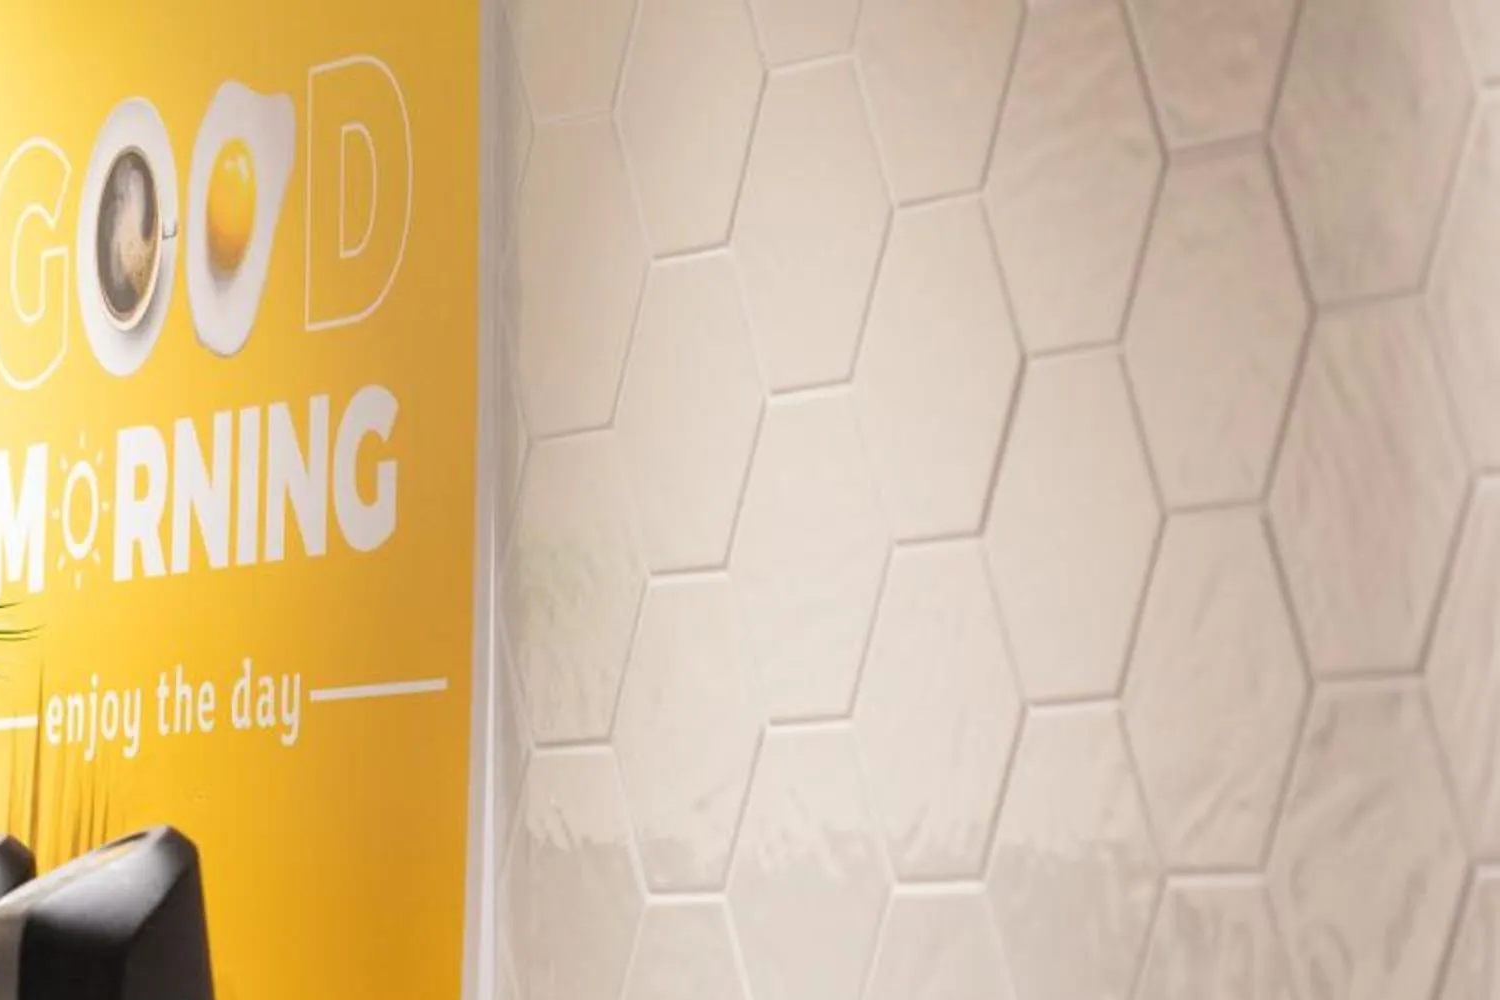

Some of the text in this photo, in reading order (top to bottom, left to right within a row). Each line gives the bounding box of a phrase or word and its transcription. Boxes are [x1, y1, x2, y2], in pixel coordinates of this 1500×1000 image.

[45, 657, 301, 762] enjoy the day
